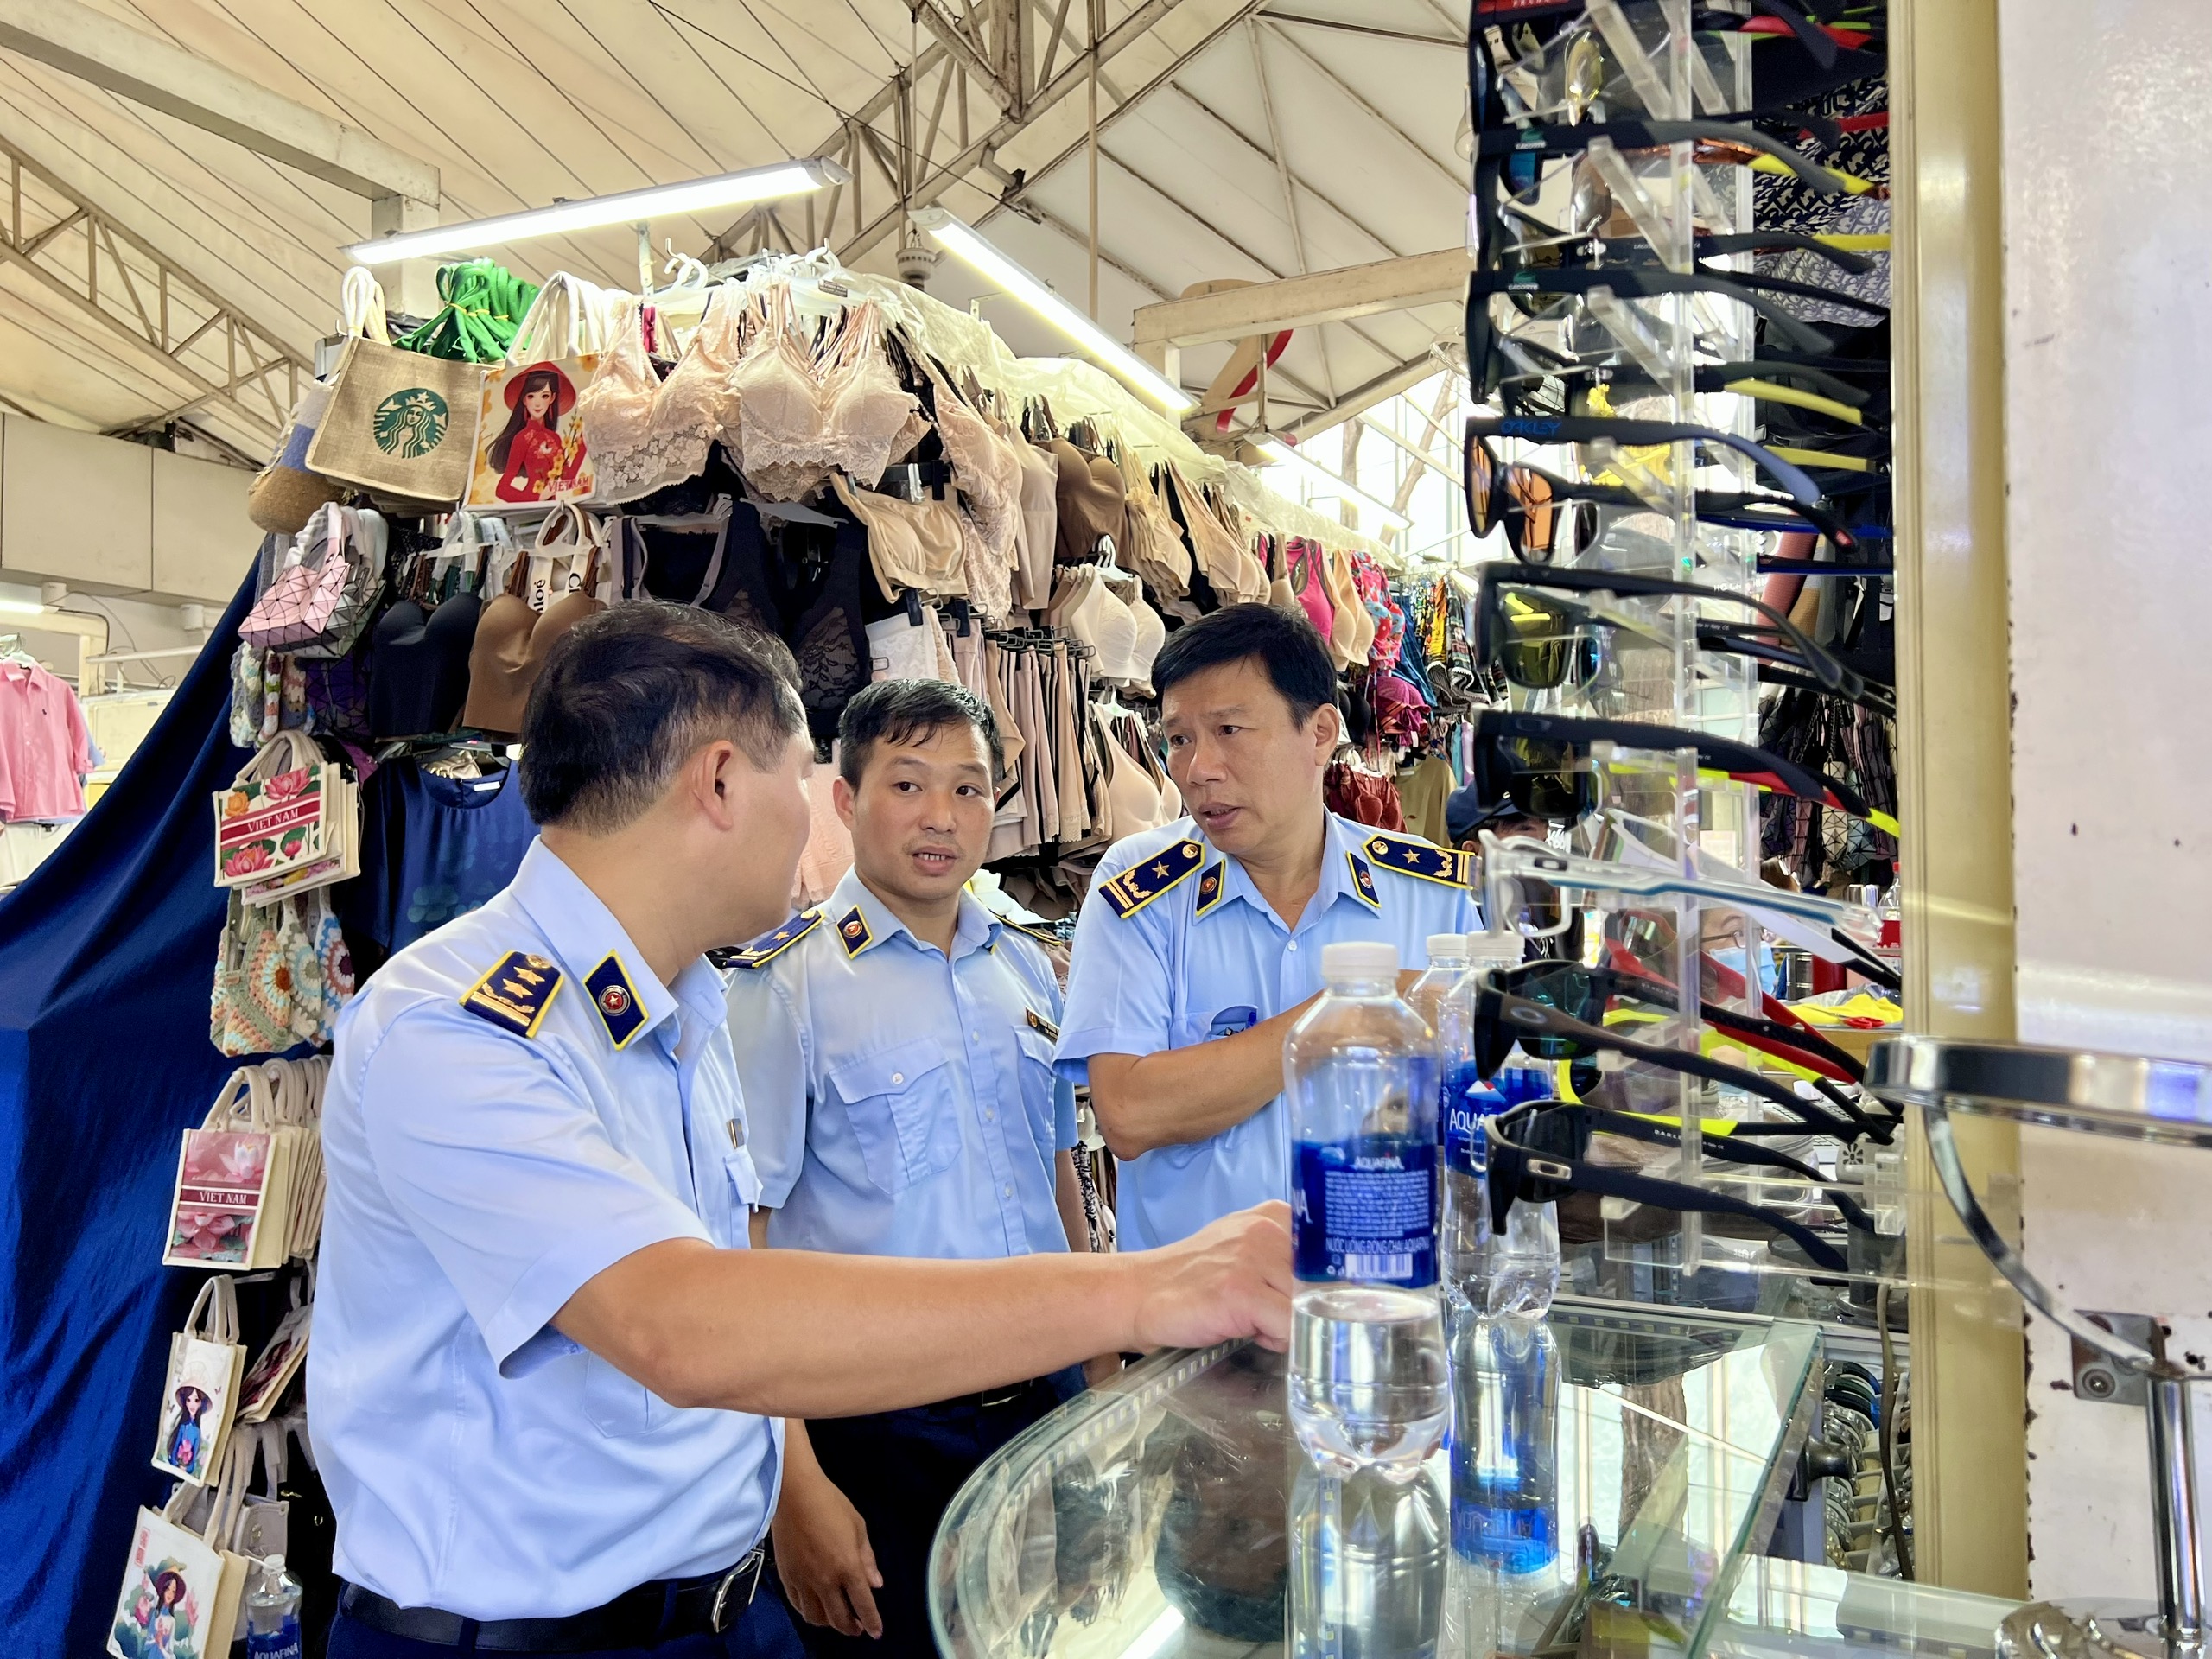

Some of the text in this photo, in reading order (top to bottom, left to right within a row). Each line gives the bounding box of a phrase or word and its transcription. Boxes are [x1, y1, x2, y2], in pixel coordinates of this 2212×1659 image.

[247, 808, 299, 833] VIET NAM
[1353, 1155, 1405, 1171] AQUAFINA
[199, 1191, 247, 1205] VIET NAM
